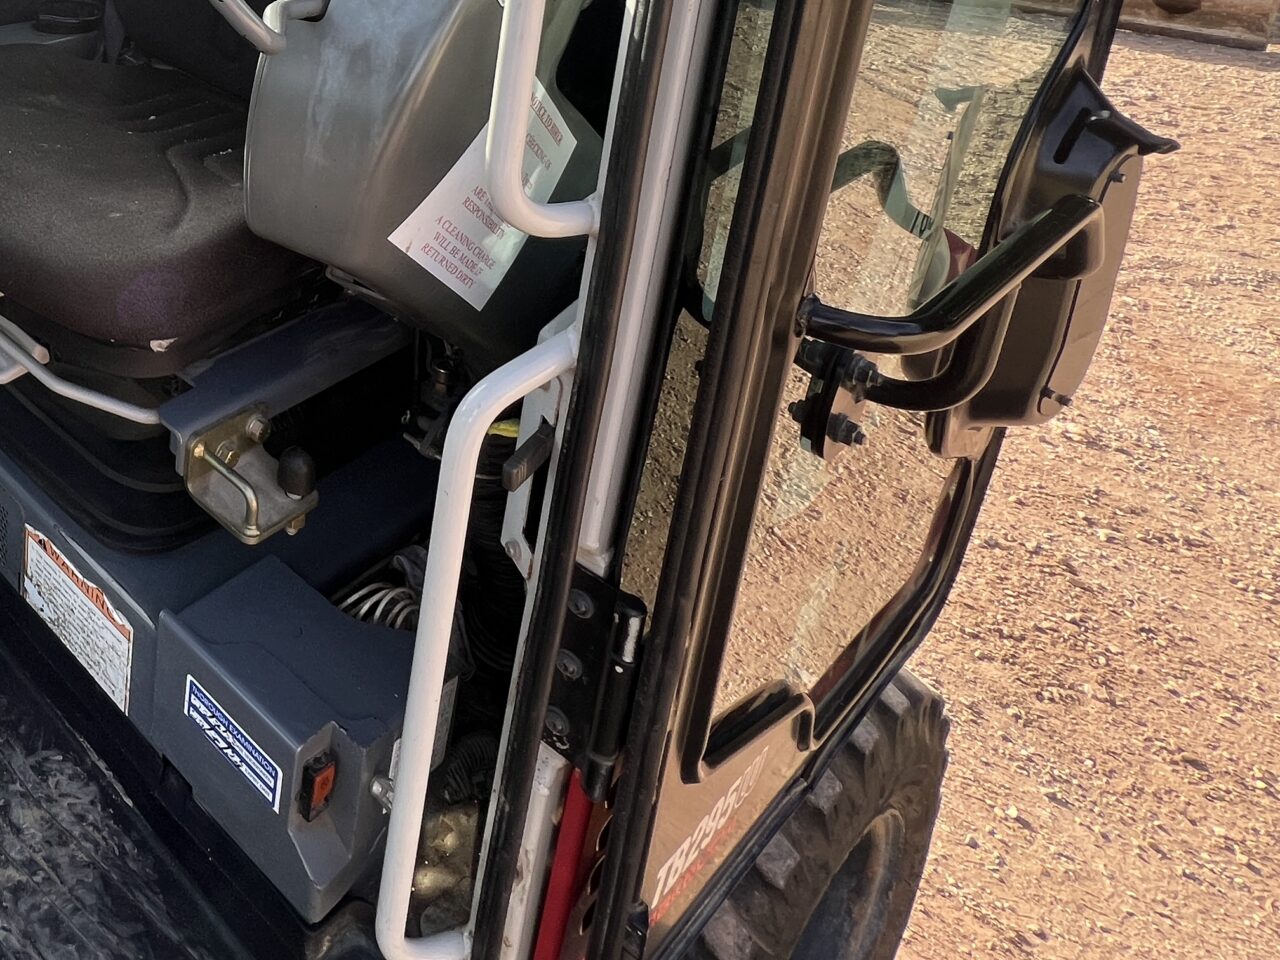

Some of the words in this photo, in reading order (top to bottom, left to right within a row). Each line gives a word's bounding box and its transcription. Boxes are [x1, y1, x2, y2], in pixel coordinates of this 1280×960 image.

[472, 185, 487, 202] ARE
[462, 196, 505, 240] RESPONSIBILITY
[433, 231, 450, 251] WILL
[449, 245, 461, 259] BE
[460, 252, 478, 273] MADE
[435, 215, 444, 225] A
[442, 220, 474, 251] CLEANING
[473, 246, 496, 270] CHARGE
[421, 243, 459, 275] RETURNED
[455, 267, 474, 289] DIRTY
[191, 685, 228, 727] THOROUGH
[229, 724, 276, 777] EXAMINATION
